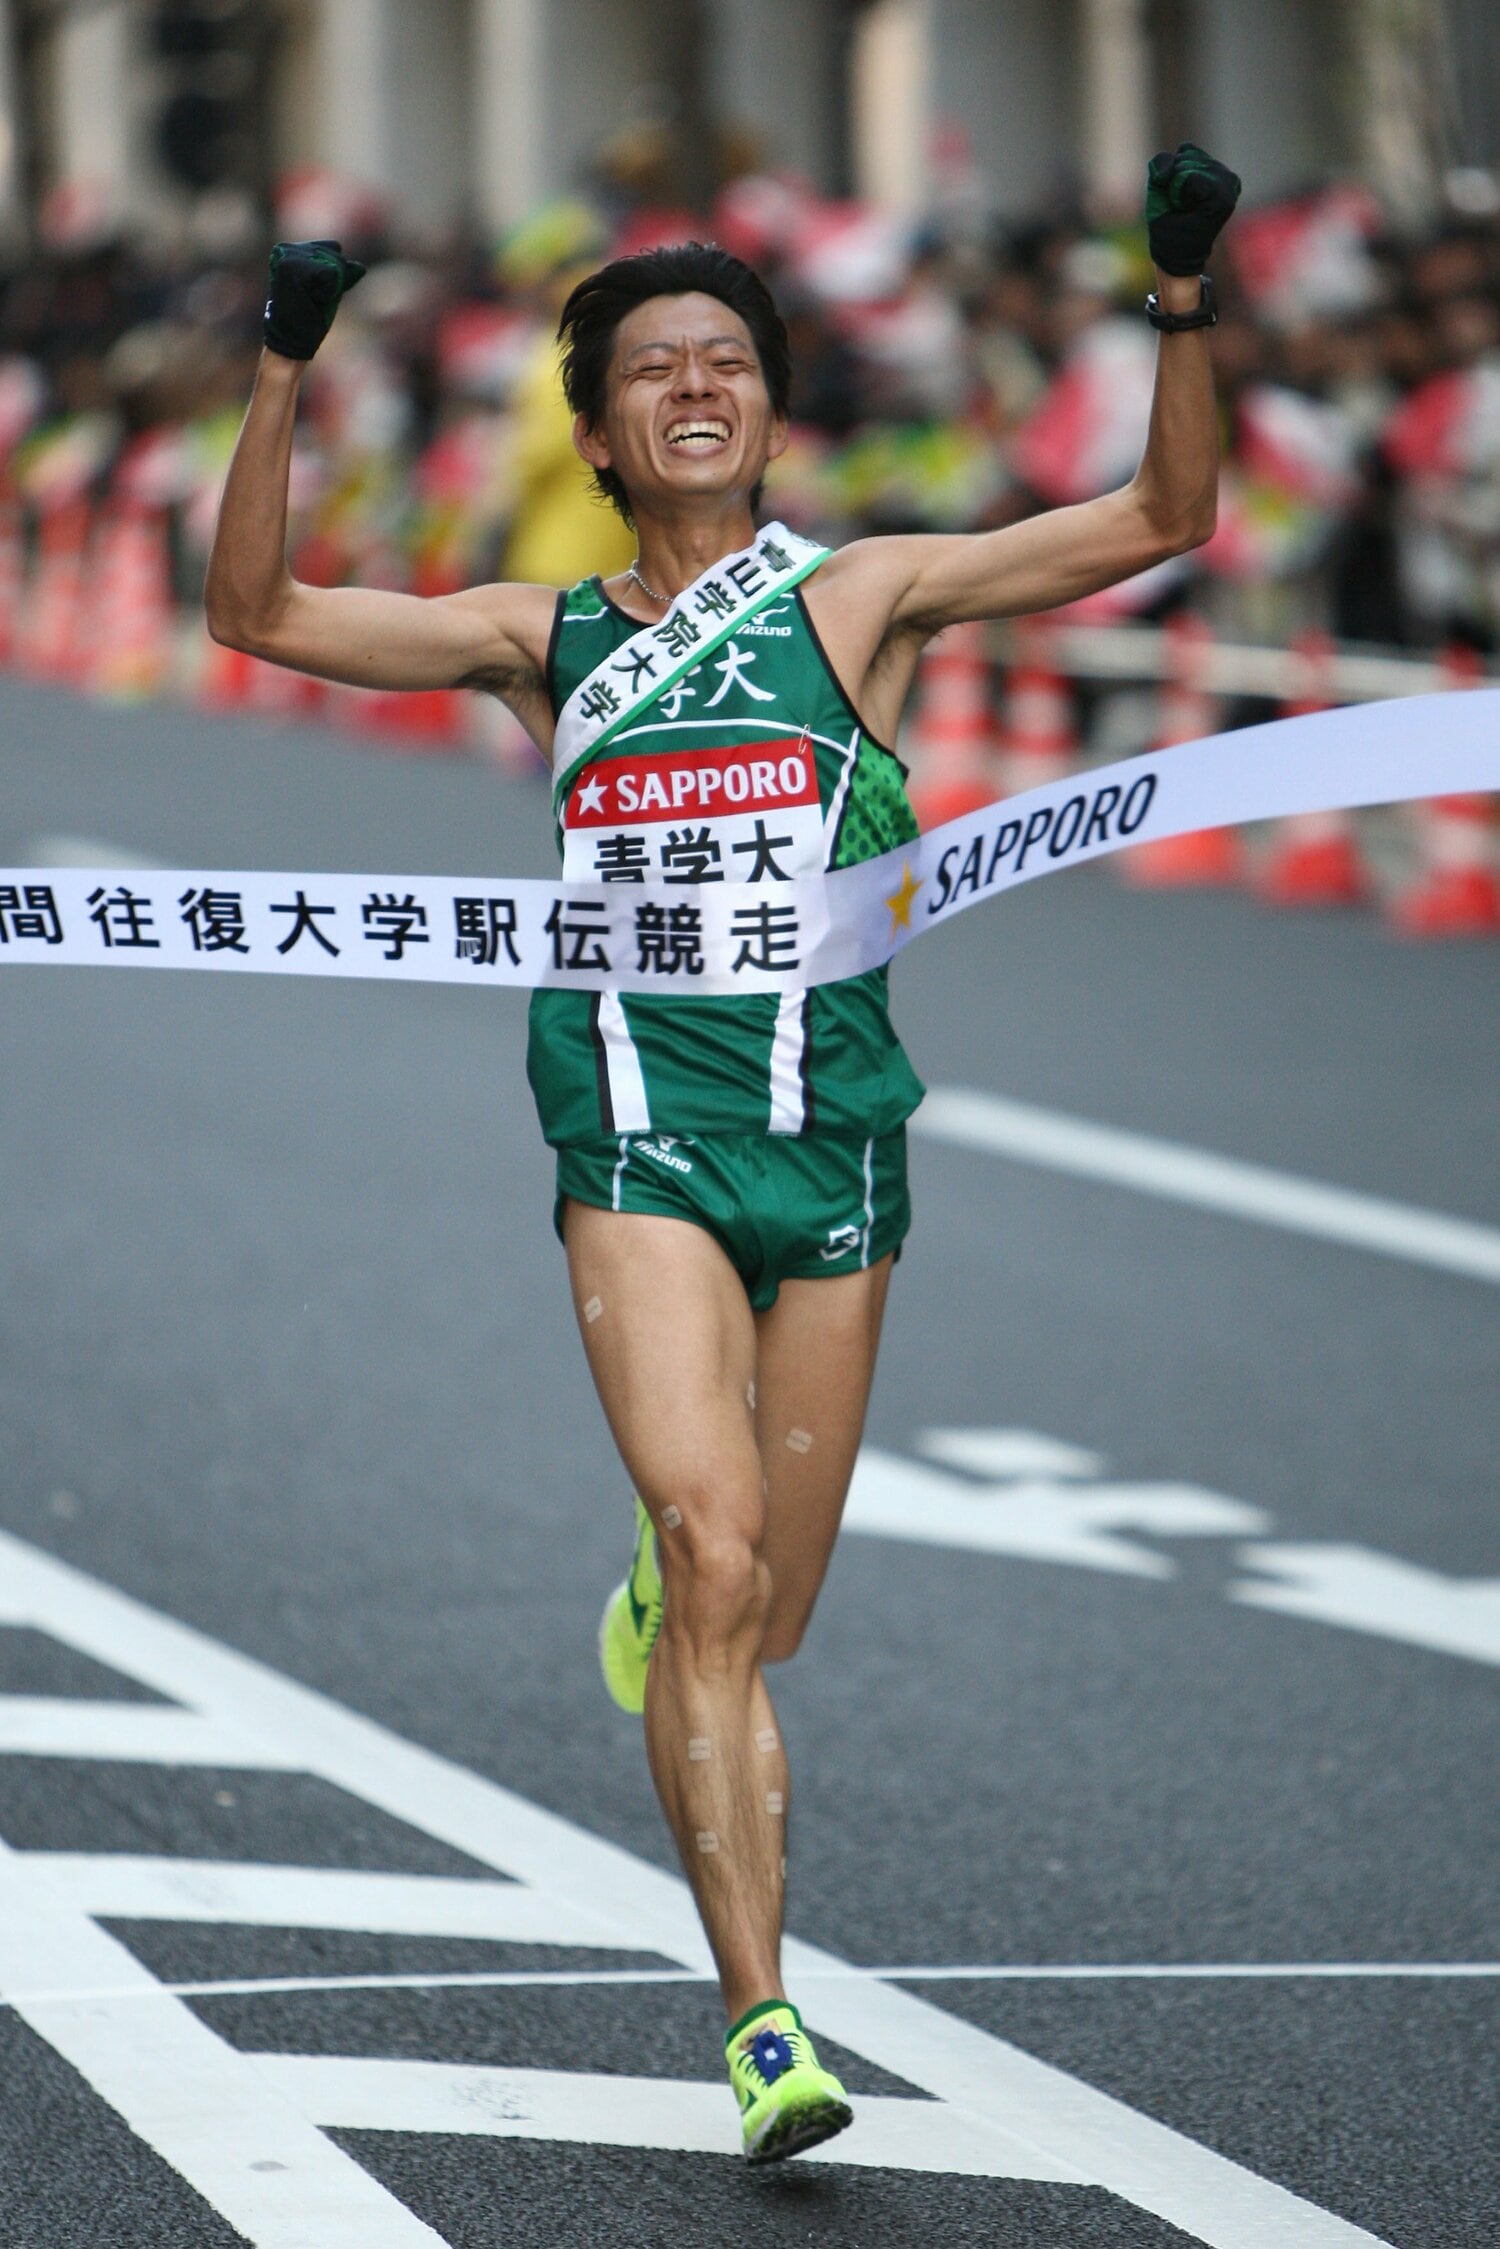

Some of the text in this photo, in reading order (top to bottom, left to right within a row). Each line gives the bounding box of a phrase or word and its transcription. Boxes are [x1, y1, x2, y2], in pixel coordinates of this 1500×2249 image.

[616, 757, 806, 812] SAPPORO
[594, 819, 795, 883] 青学大
[928, 774, 1157, 914] SAPPORO
